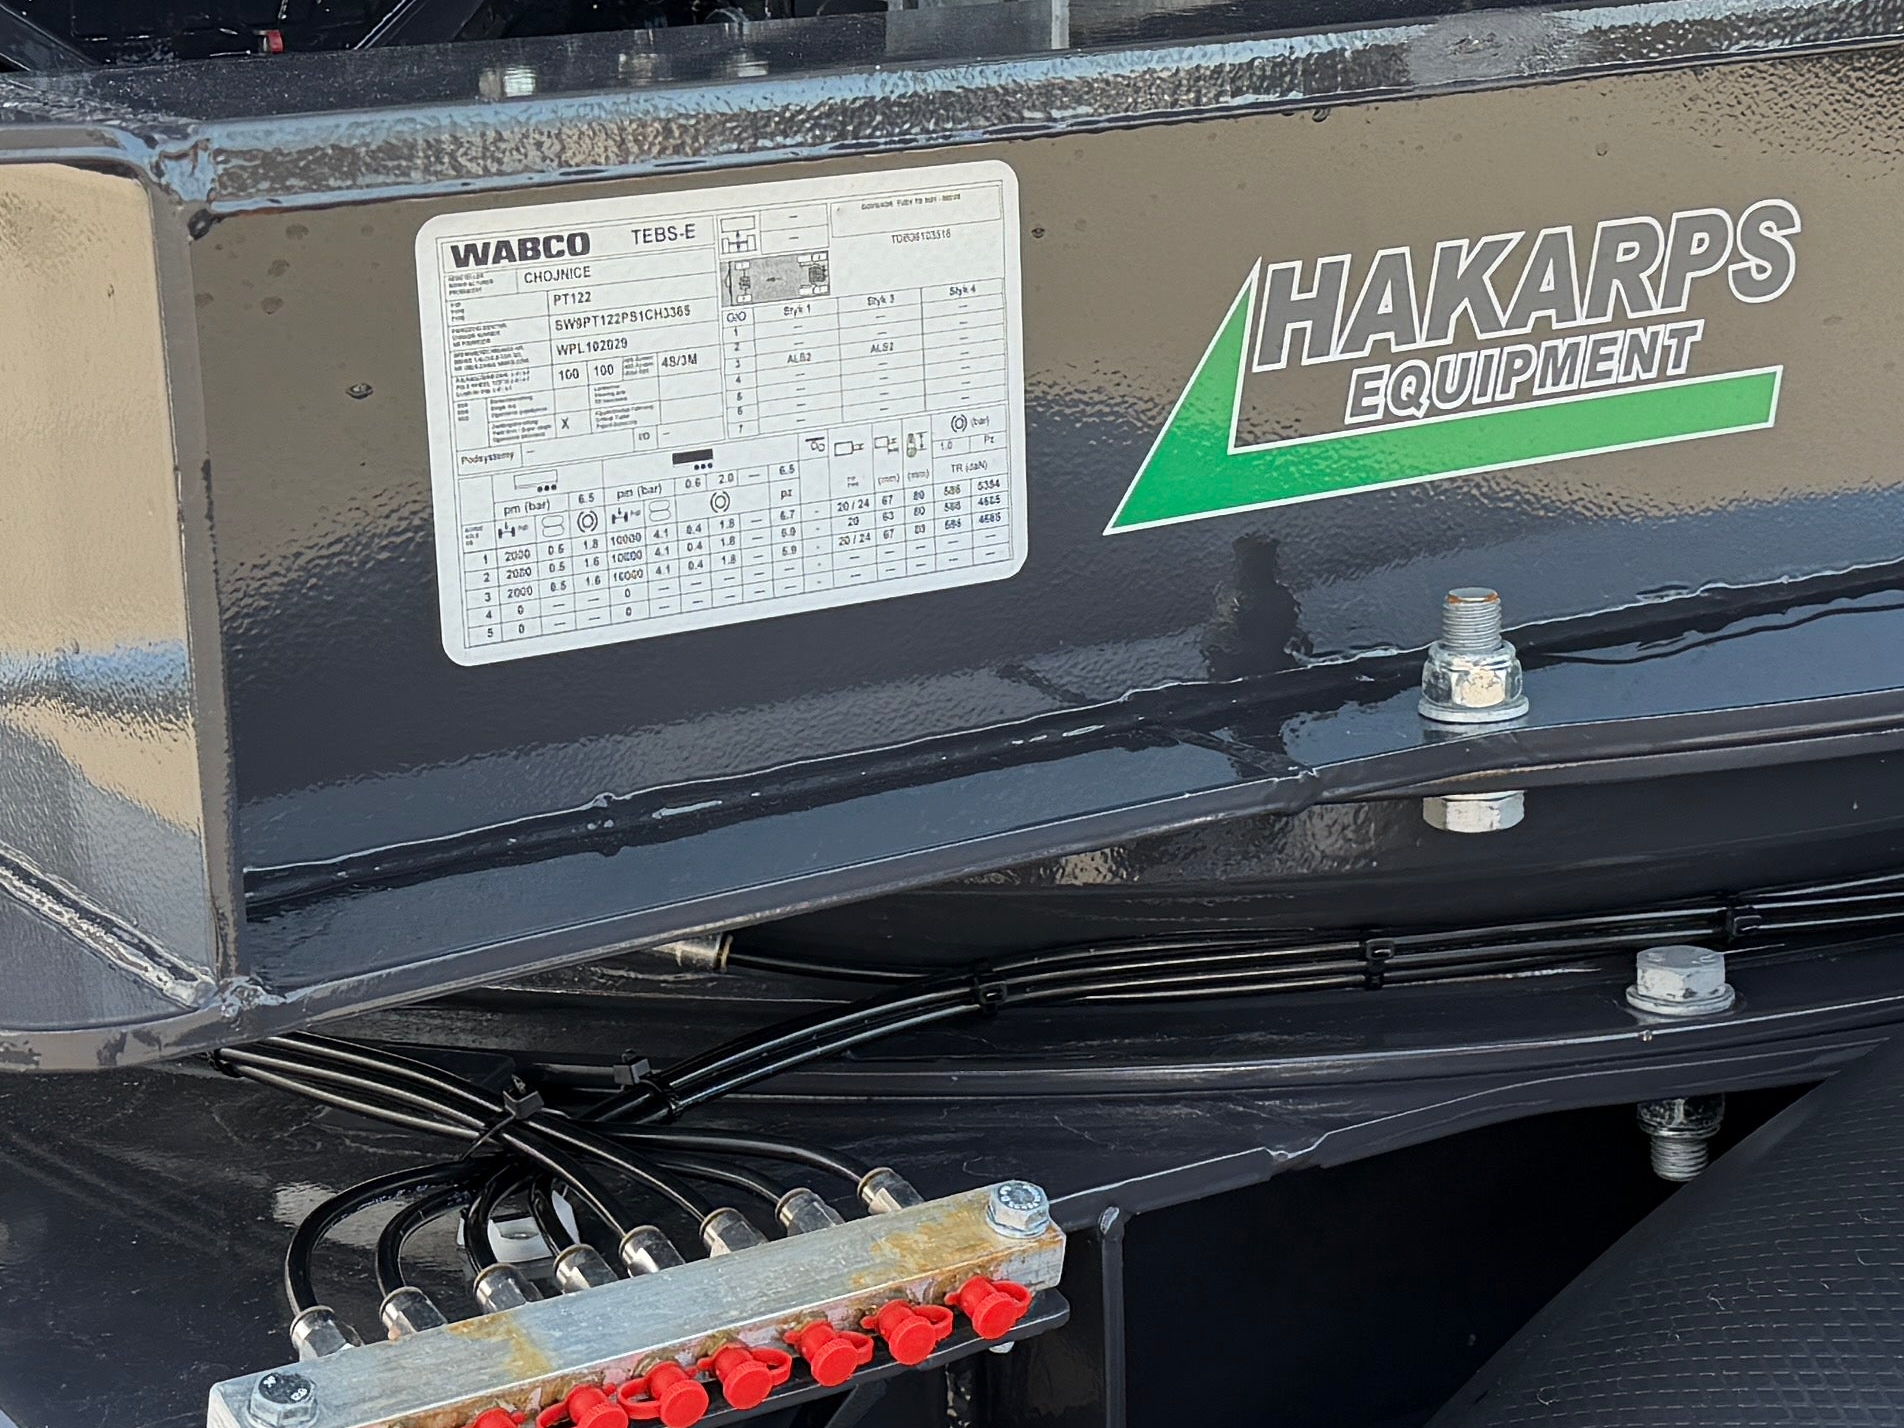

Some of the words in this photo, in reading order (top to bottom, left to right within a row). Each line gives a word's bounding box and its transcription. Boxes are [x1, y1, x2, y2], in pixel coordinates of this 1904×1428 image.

[450, 231, 590, 268] WABCO
[631, 223, 695, 245] TEBS-E
[523, 265, 591, 284] CHOJNICE
[1252, 198, 1801, 373] HAKARPS
[553, 291, 591, 306] PT122
[558, 368, 579, 381] 100
[594, 363, 614, 376] 100
[1344, 319, 1704, 424] EQUIPMENT
[560, 417, 569, 429] X
[524, 497, 550, 513] (bar)
[483, 553, 487, 564] 1
[483, 571, 490, 582] 2
[485, 609, 492, 619] 4
[624, 587, 630, 598] 0
[486, 627, 493, 638] 5
